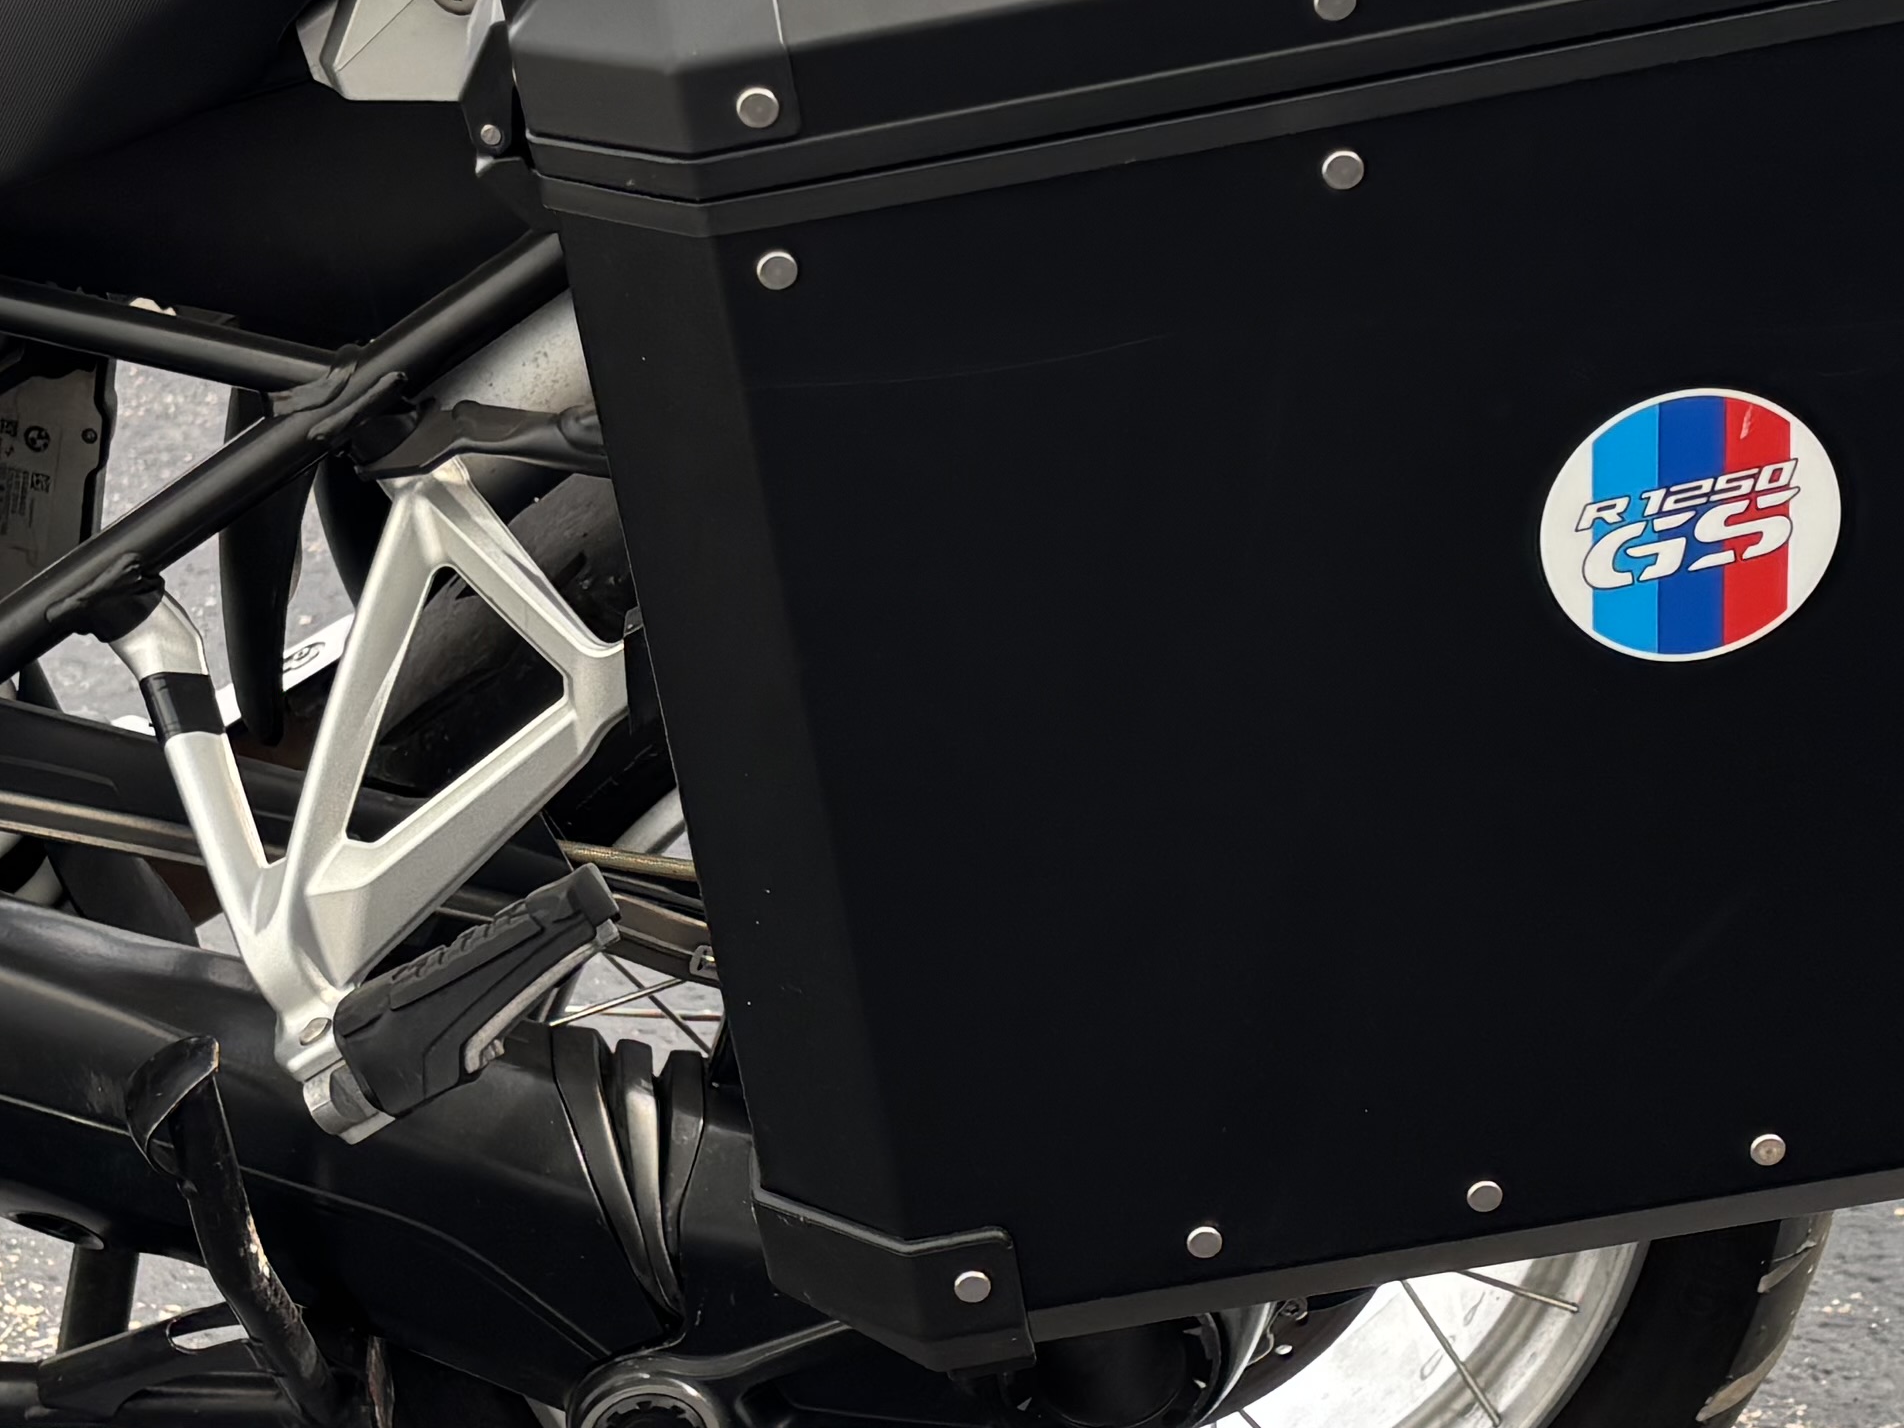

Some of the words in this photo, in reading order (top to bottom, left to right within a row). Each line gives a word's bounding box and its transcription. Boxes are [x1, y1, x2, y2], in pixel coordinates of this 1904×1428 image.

[1575, 496, 1630, 532] R
[1641, 457, 1799, 517] 1250
[1581, 486, 1801, 590] GS
